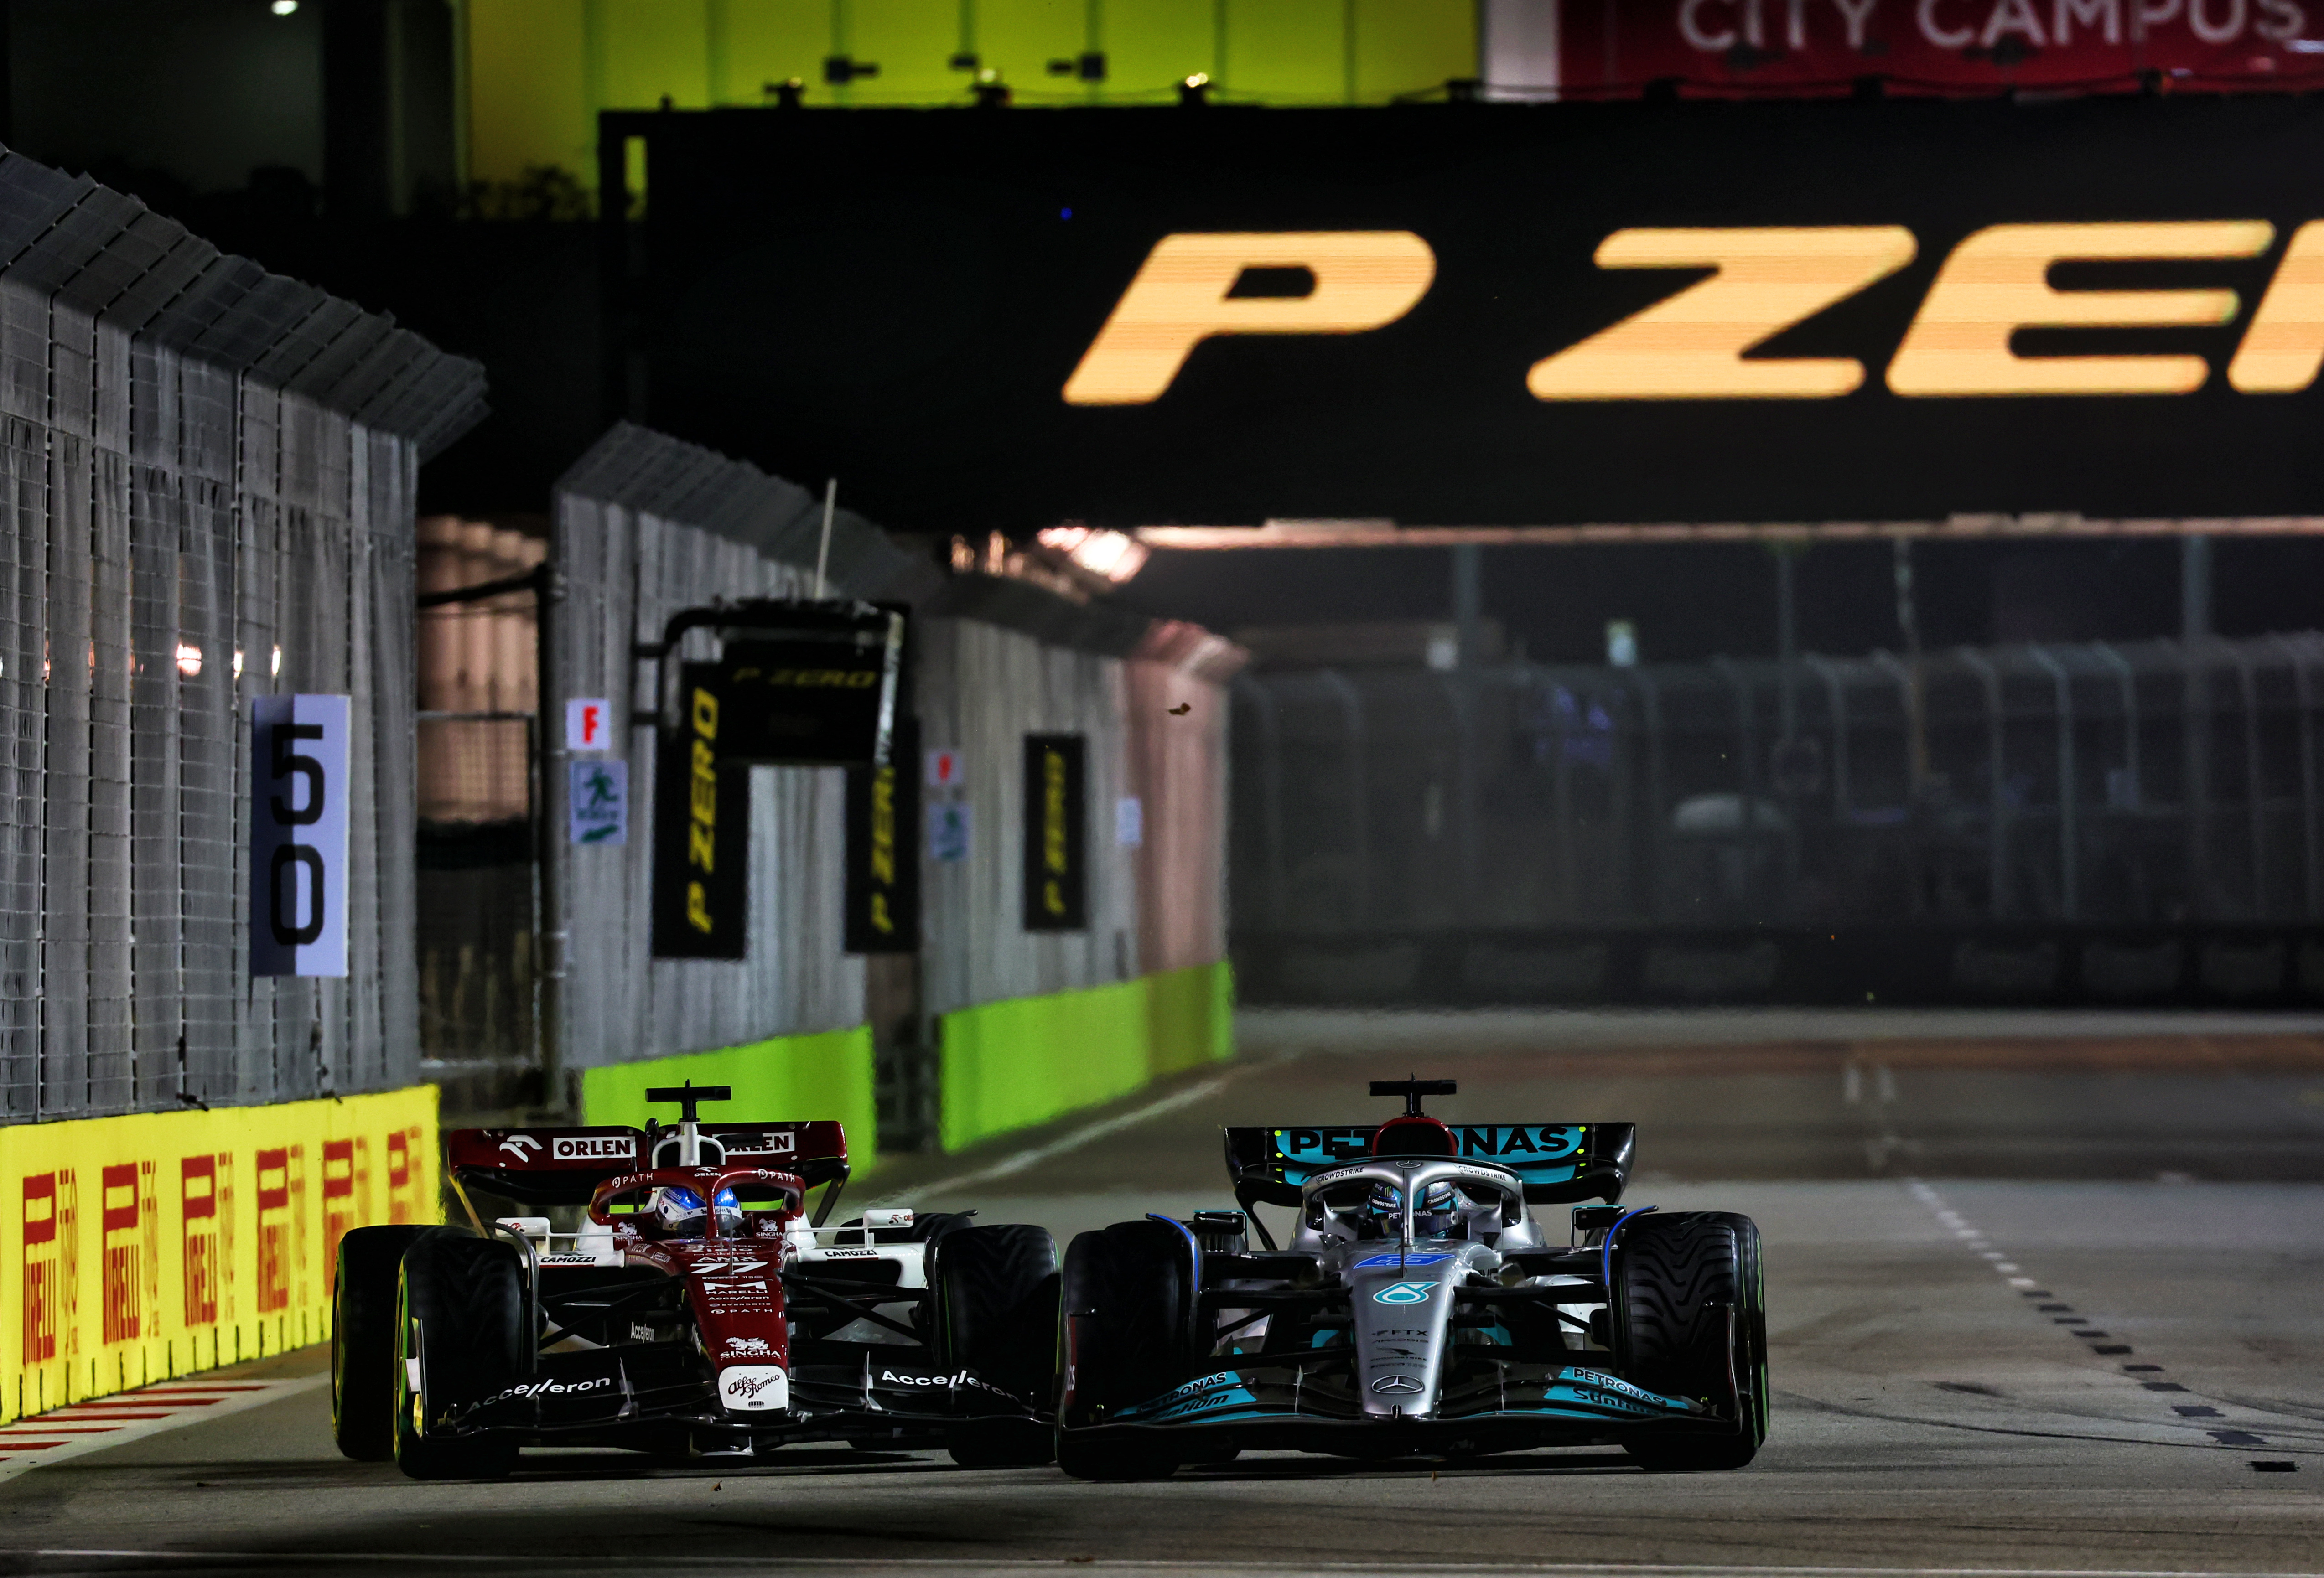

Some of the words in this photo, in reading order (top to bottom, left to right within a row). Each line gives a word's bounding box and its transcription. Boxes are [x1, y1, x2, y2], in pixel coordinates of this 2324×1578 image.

[1062, 230, 1437, 404] P
[1526, 219, 2324, 400] ZE
[582, 706, 599, 744] F
[689, 687, 719, 875] ZERO
[687, 880, 713, 934] P
[558, 1140, 631, 1156] ORLEN
[623, 1173, 654, 1185] PATH
[771, 1173, 795, 1183] PATH
[1318, 1167, 1364, 1183] CROWDSTRIKE
[1459, 1165, 1506, 1181] CROWDSTRIKE
[824, 1249, 877, 1257] CAMOZZI
[690, 1262, 768, 1273] 77
[466, 1378, 611, 1413] Accelleron
[728, 1376, 754, 1397] Alfa
[745, 1374, 780, 1398] Romeo
[882, 1370, 1022, 1403] Accelleron
